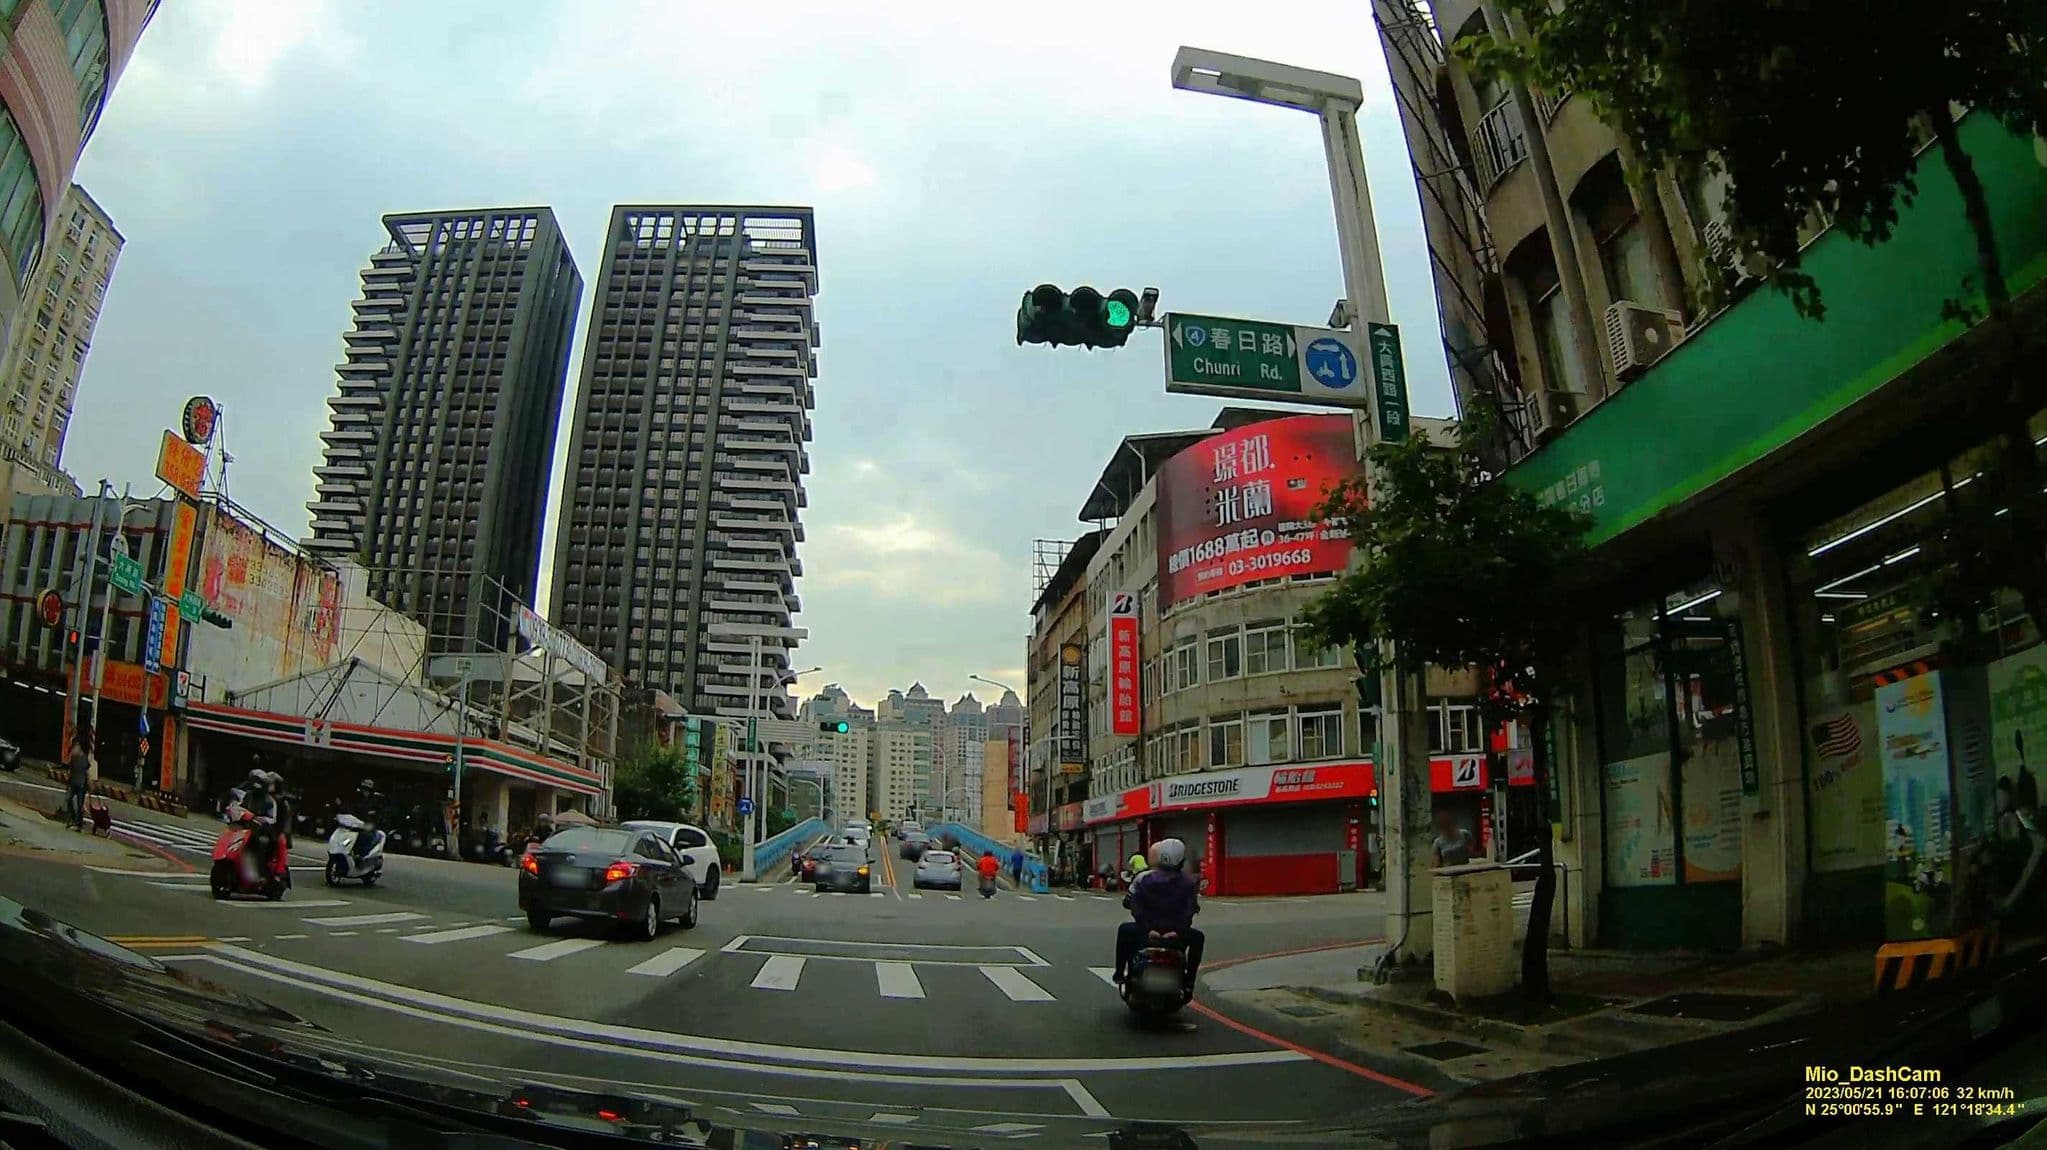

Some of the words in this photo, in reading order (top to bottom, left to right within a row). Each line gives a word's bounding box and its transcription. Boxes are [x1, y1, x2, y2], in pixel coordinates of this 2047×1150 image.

[1210, 327, 1284, 357] 春日路
[1193, 357, 1241, 377] Chunri
[1260, 363, 1283, 381] Rd.
[1215, 479, 1272, 528] 米蘭
[1229, 548, 1312, 576] 03-3019668
[1062, 665, 1081, 710] 新高原
[1117, 630, 1133, 723] 新高原輪胎館
[1168, 778, 1239, 798] BRIDGESTONE
